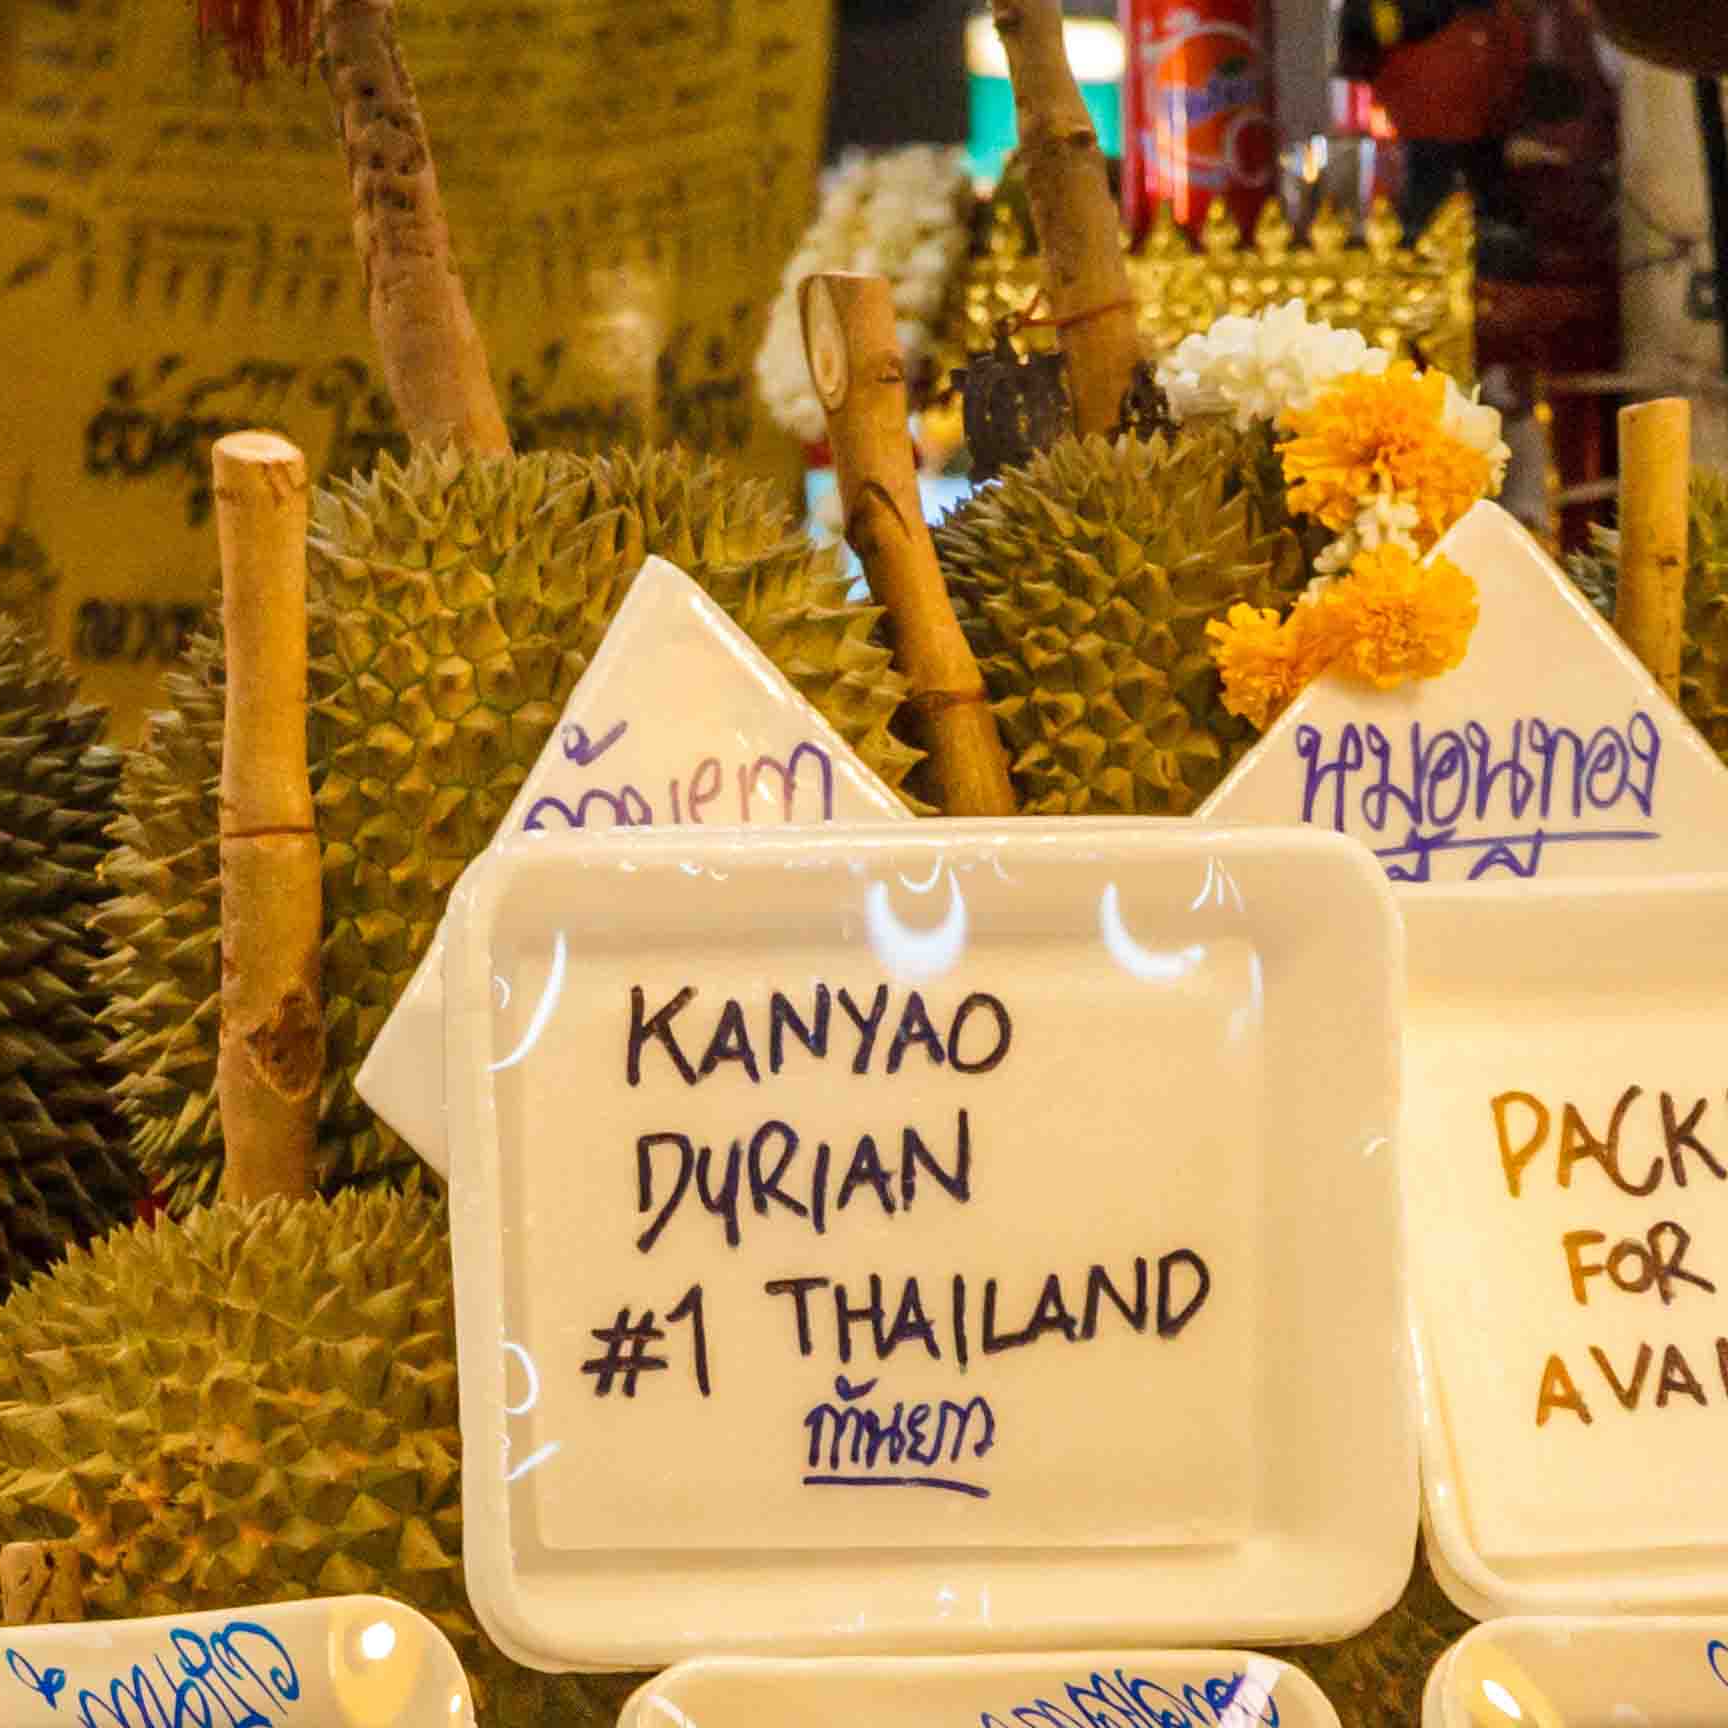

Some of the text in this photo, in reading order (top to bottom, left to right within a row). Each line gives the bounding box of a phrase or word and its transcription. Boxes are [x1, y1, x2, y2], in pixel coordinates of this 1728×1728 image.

[1296, 711, 1661, 831] หมอนทอง
[625, 983, 1012, 1086] KANYAO
[635, 1108, 970, 1254] DURIAN
[1562, 1220, 1716, 1304] FOR
[580, 1248, 1211, 1397] #1 THAILAND
[804, 1375, 996, 1469] ก้านยาว
